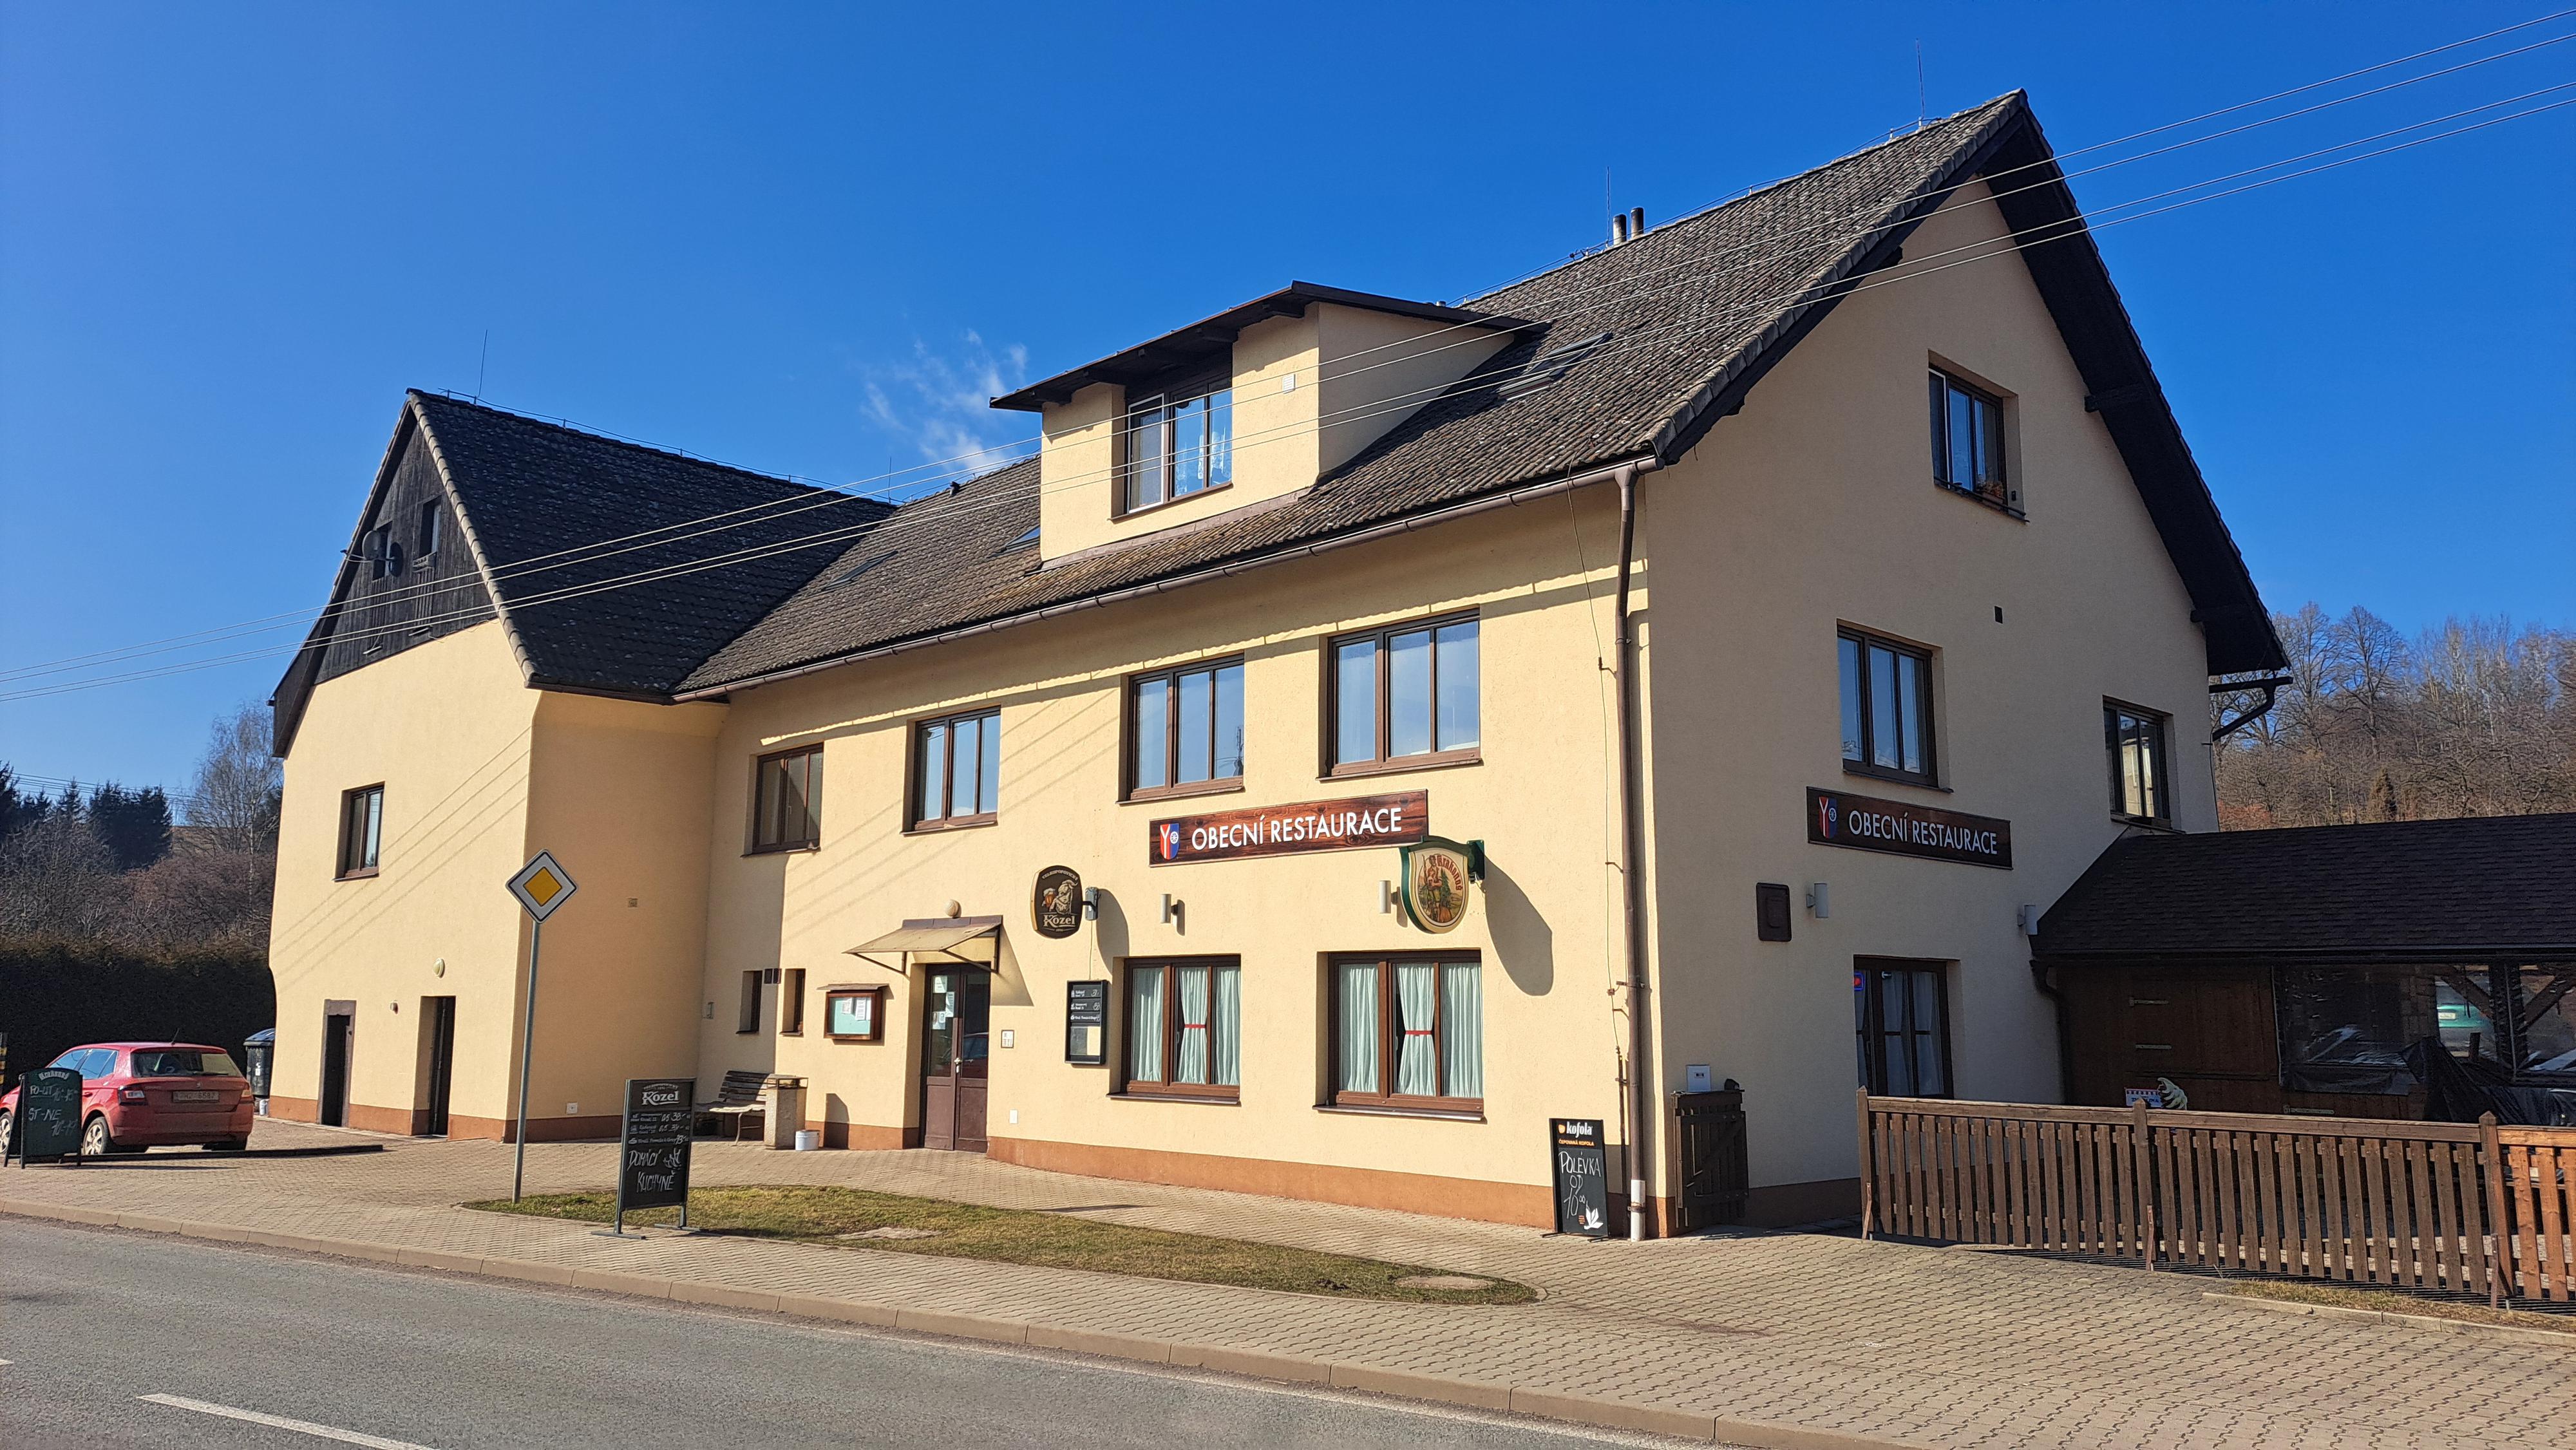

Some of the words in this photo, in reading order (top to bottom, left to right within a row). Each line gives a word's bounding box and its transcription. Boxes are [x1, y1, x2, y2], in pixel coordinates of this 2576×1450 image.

[1191, 816, 1264, 851] OBECNÍ
[1271, 807, 1403, 843] RESTAURACE
[1849, 811, 1908, 842] OBECNÍ
[1913, 821, 1998, 855] RESTAURACE
[1043, 914, 1076, 928] Kozel
[641, 1091, 680, 1106] Kozel
[28, 1107, 61, 1121] ST-NE
[1566, 1121, 1593, 1138] kofola
[627, 1149, 662, 1171] DOMÁCÍ
[1558, 1151, 1601, 1177] POLÉVKA
[636, 1170, 676, 1193] KUCHYNĚ
[1569, 1174, 1584, 1195] OD
